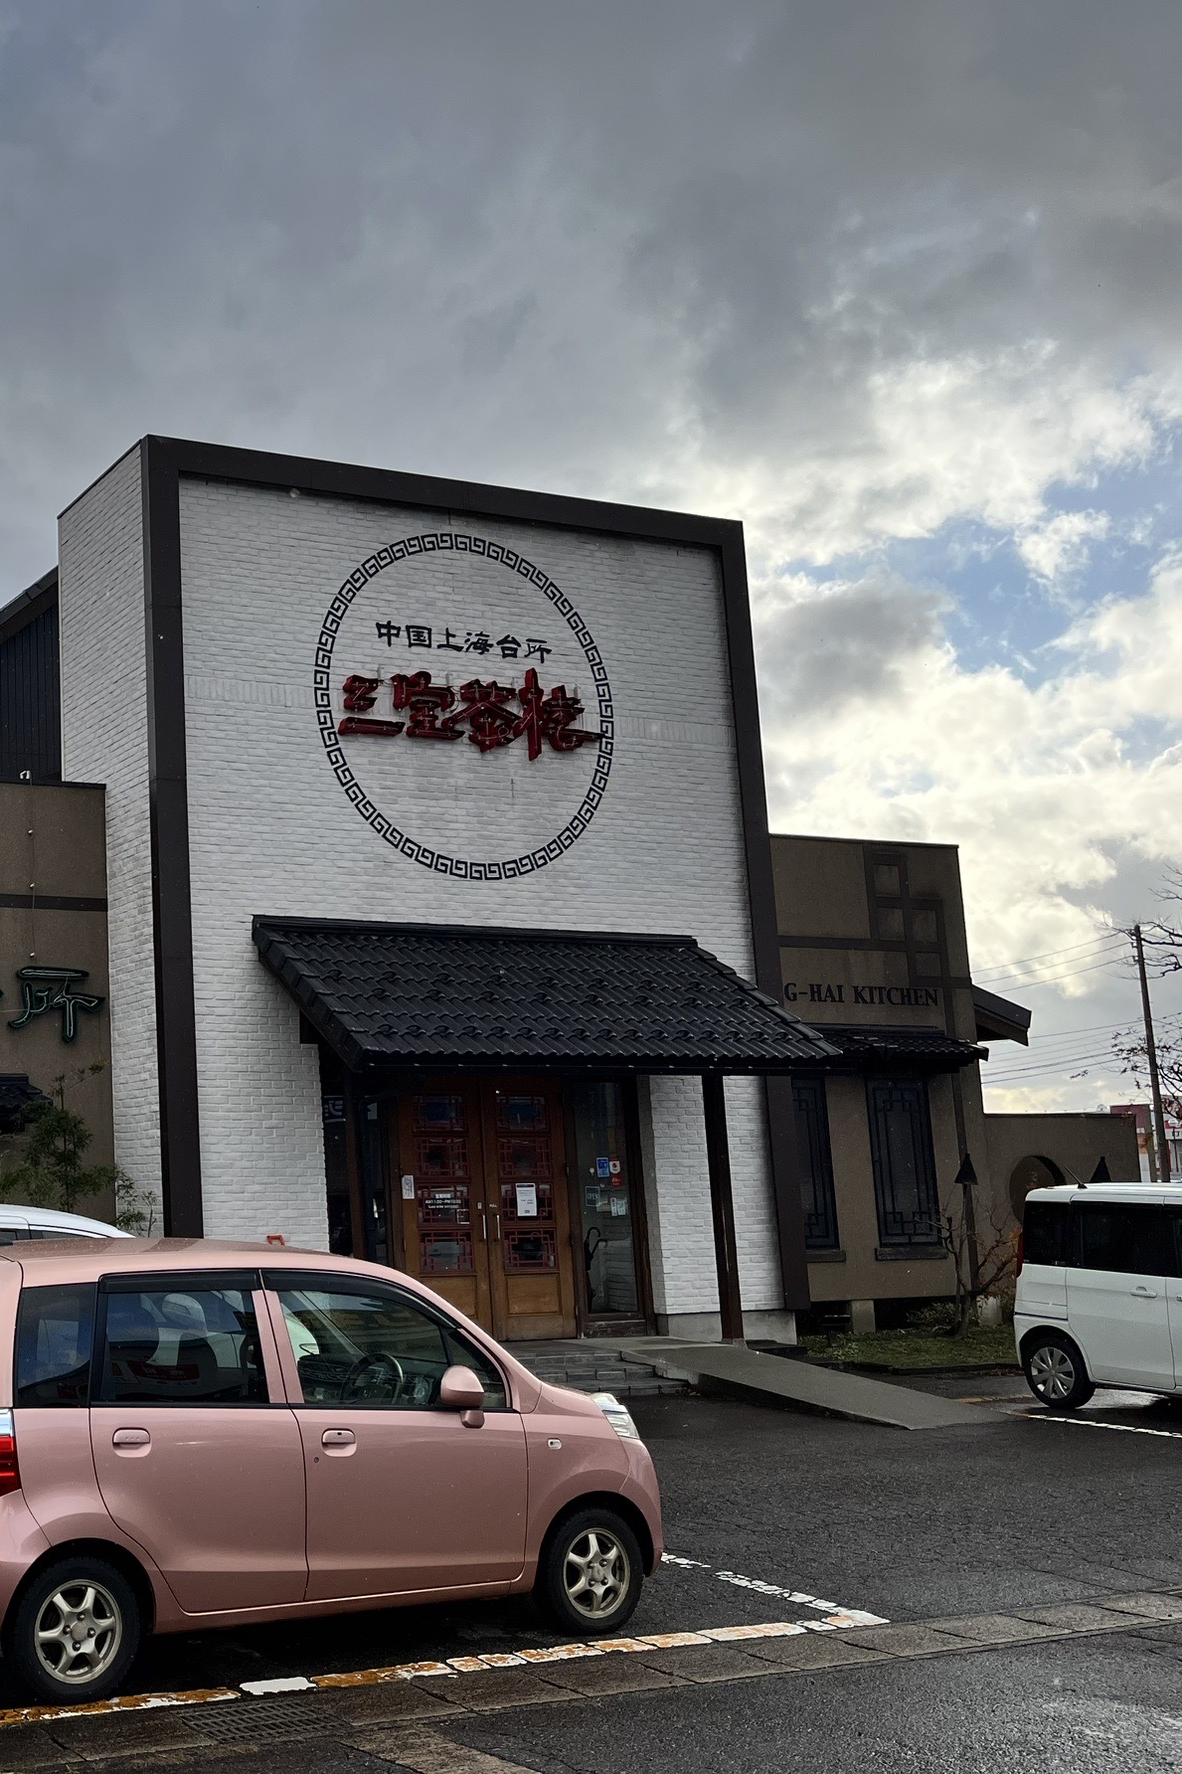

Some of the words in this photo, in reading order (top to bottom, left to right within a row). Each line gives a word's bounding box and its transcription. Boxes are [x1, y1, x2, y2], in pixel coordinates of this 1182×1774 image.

[375, 620, 553, 664] 中国上海台所
[852, 985, 939, 1007] KITCHEN
